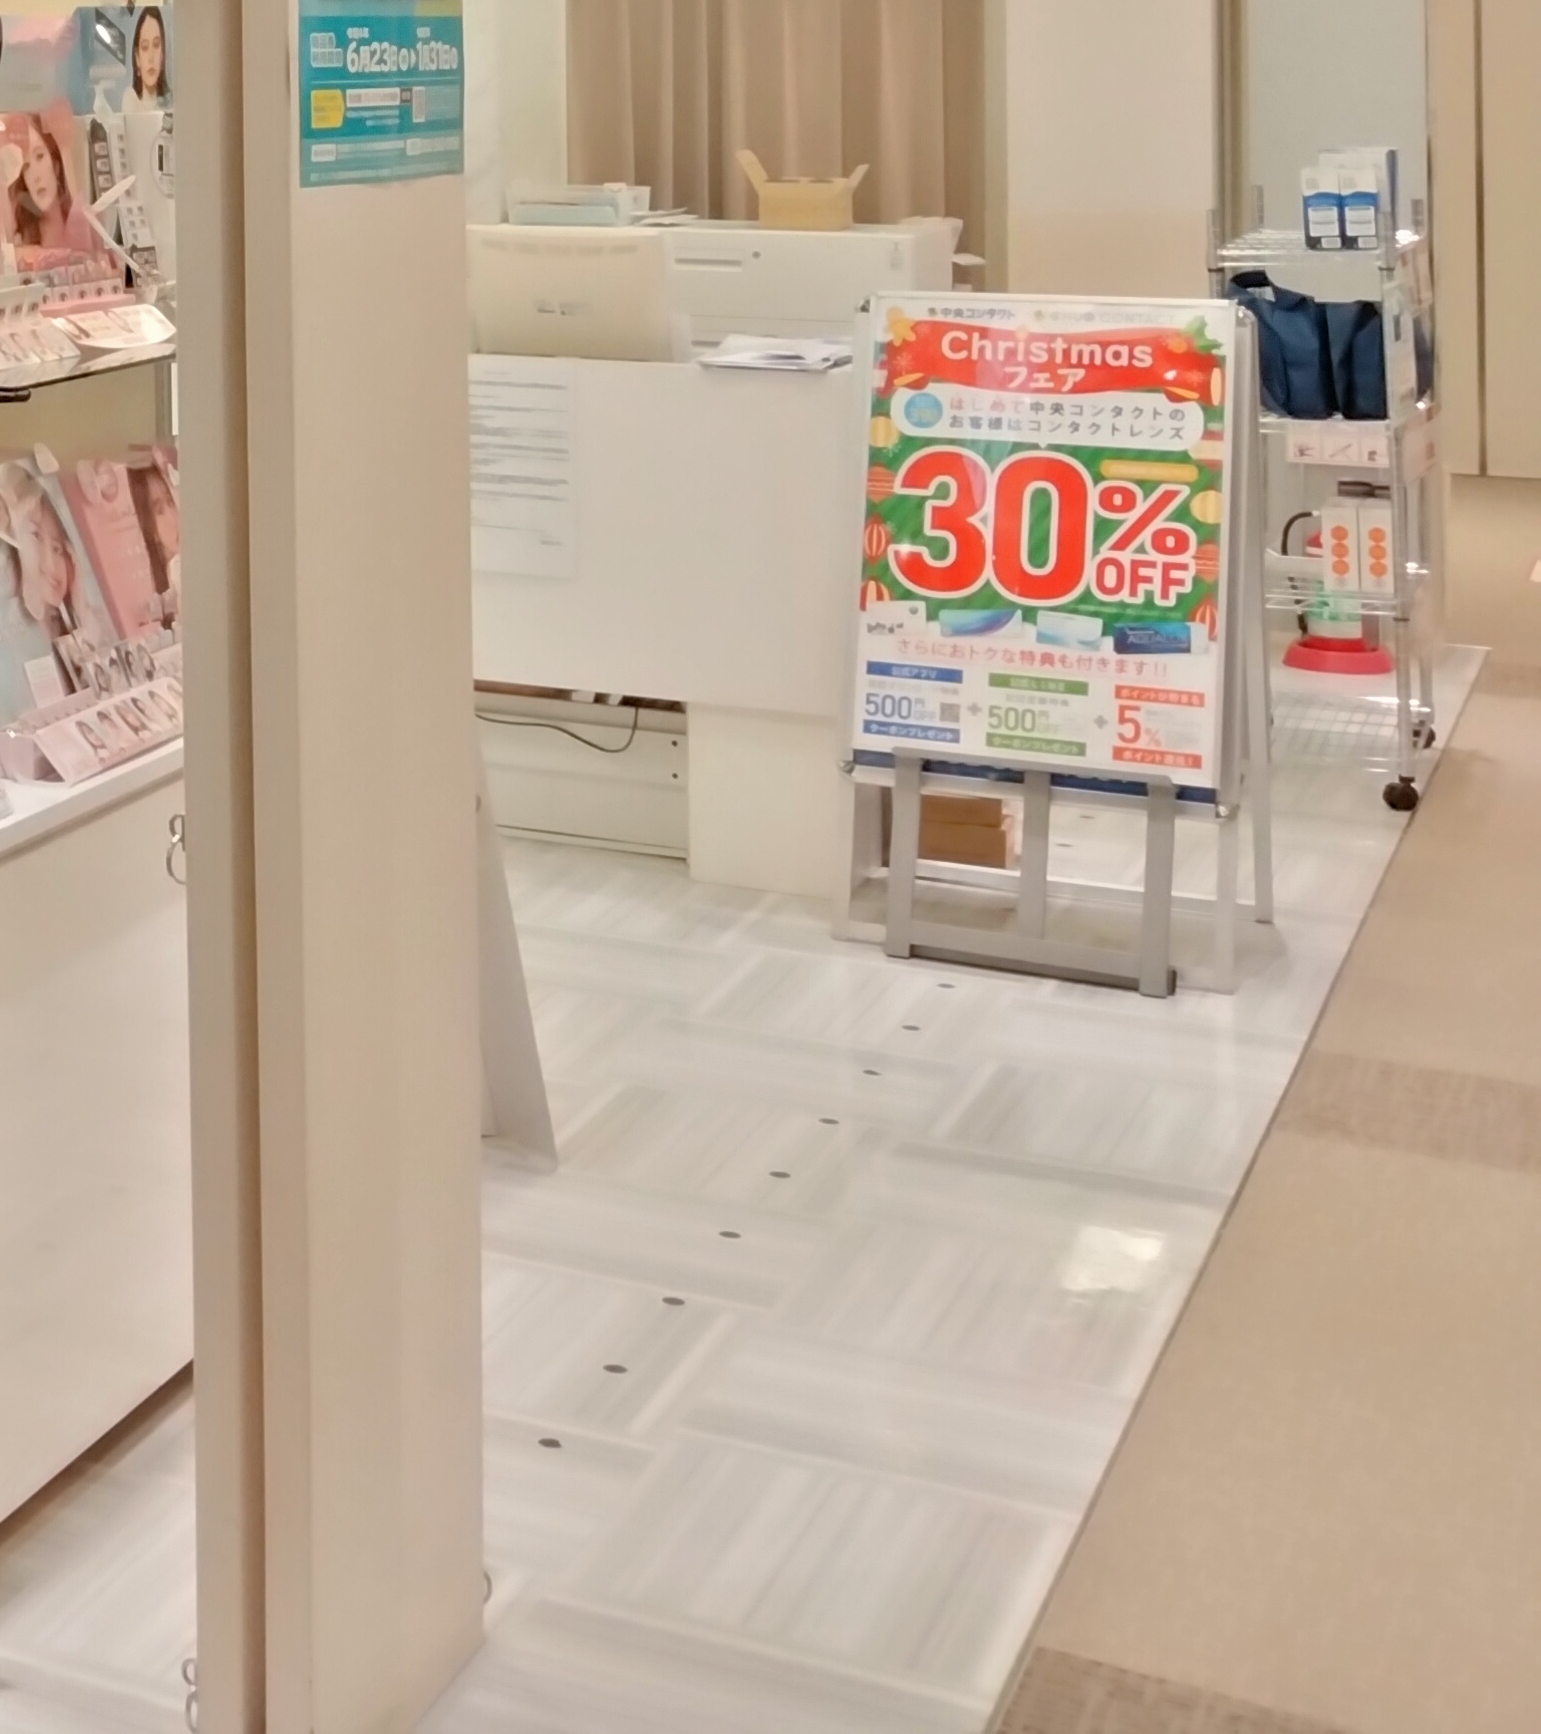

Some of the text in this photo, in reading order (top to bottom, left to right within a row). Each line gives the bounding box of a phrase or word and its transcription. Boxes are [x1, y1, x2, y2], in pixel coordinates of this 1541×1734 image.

[940, 307, 1016, 320] 中央コンタクト
[941, 330, 1153, 368] Christmas
[1003, 367, 1086, 392] フェア
[949, 414, 1186, 441] お客様はコンタクトレンズ
[1095, 557, 1190, 602] OFF
